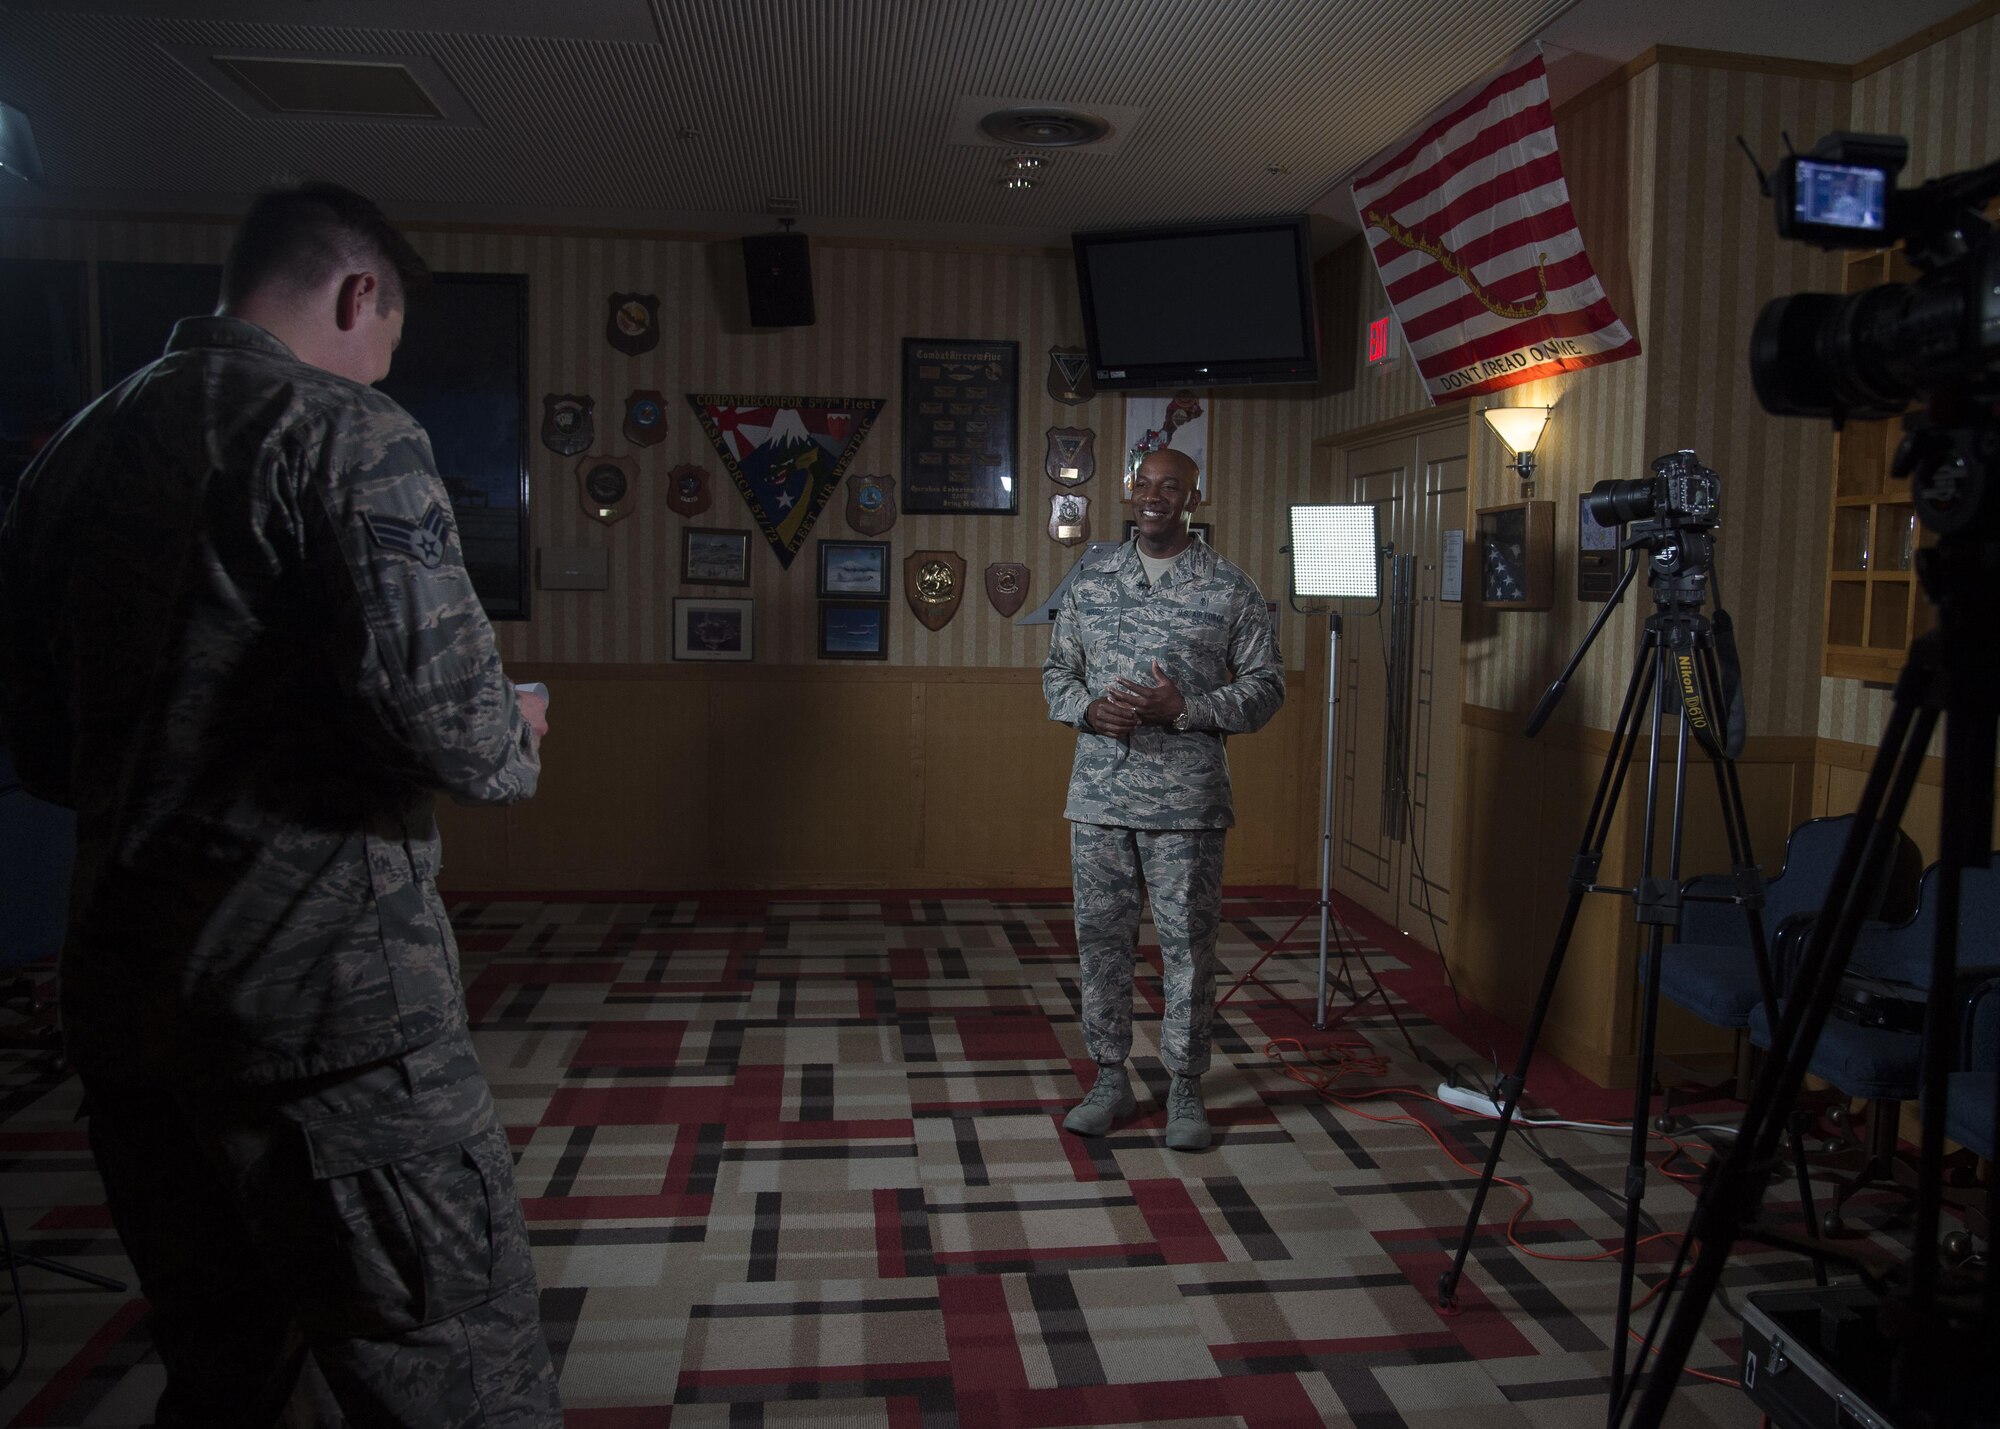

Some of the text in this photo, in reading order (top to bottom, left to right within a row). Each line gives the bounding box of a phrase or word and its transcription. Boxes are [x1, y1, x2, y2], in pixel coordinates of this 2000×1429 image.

[1369, 317, 1390, 363] EXIT
[1440, 340, 1582, 390] DONT TREAD ON ME
[696, 394, 804, 408] COMPATRECONFOR
[843, 398, 877, 410] Fleet
[699, 410, 779, 544] TASK FORCE 57/72
[788, 418, 873, 554] FLEET AIR WESTPAC
[1086, 608, 1107, 616] WRIGHT
[1177, 609, 1190, 617] U.S.
[1204, 612, 1225, 622] FORCE
[1678, 656, 1708, 728] Nikon D610
